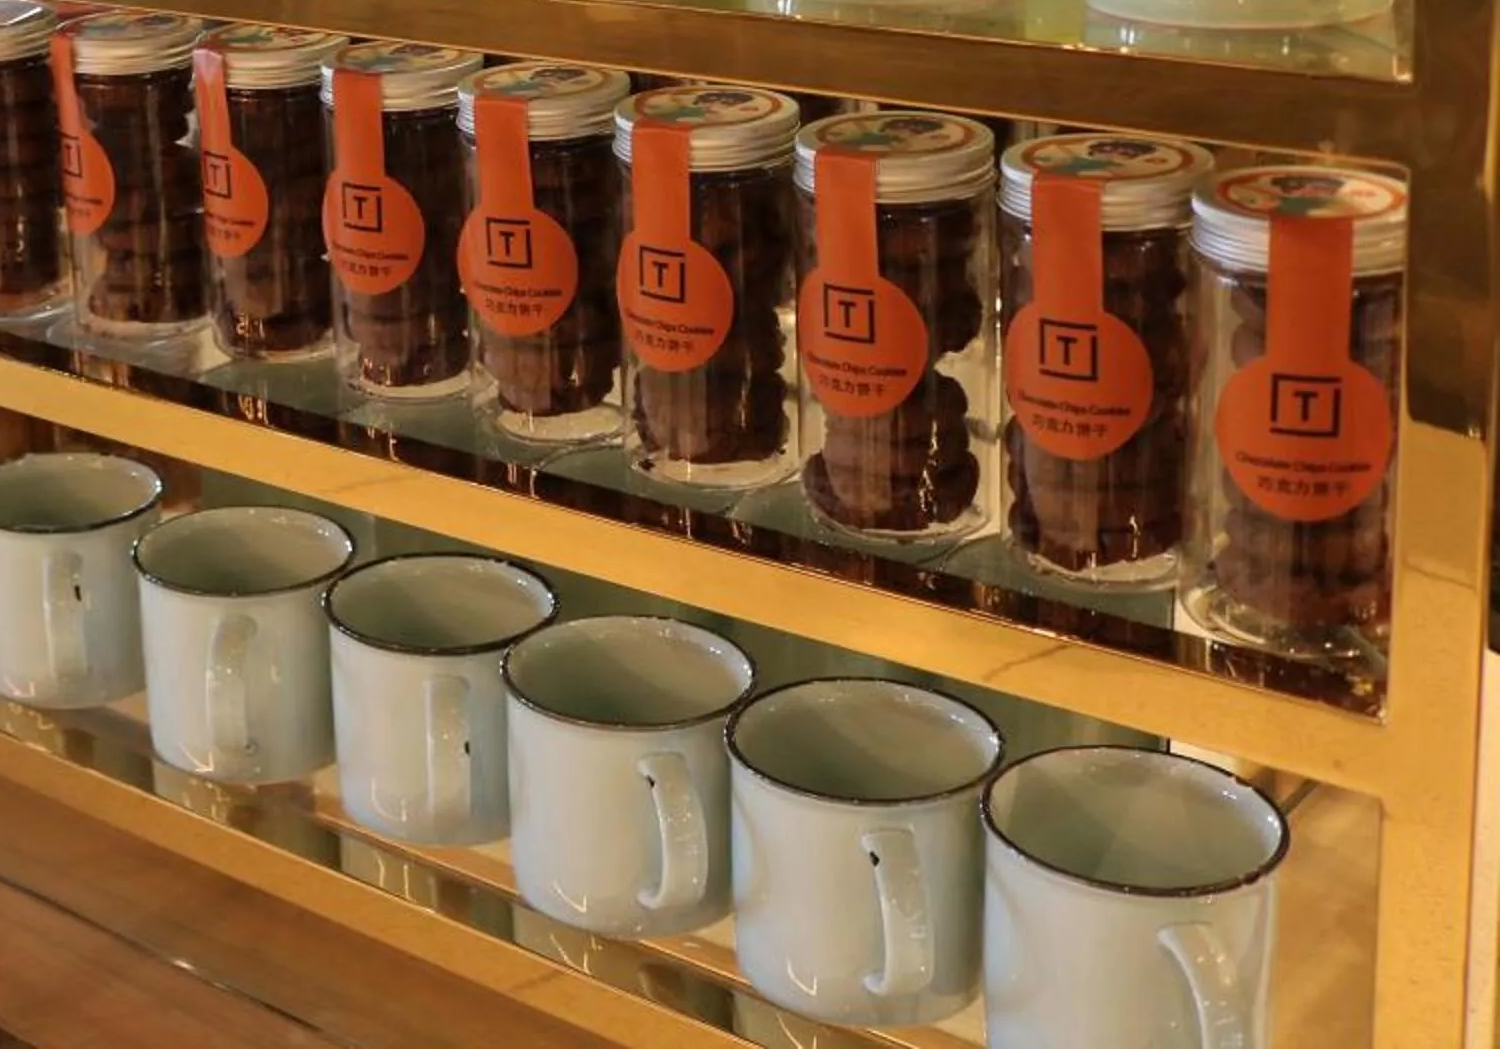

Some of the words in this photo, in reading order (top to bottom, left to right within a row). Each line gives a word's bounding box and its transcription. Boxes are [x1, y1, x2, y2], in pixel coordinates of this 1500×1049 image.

[651, 260, 669, 288] T
[838, 300, 856, 328] T
[1055, 334, 1077, 366] T
[1293, 391, 1318, 422] T
